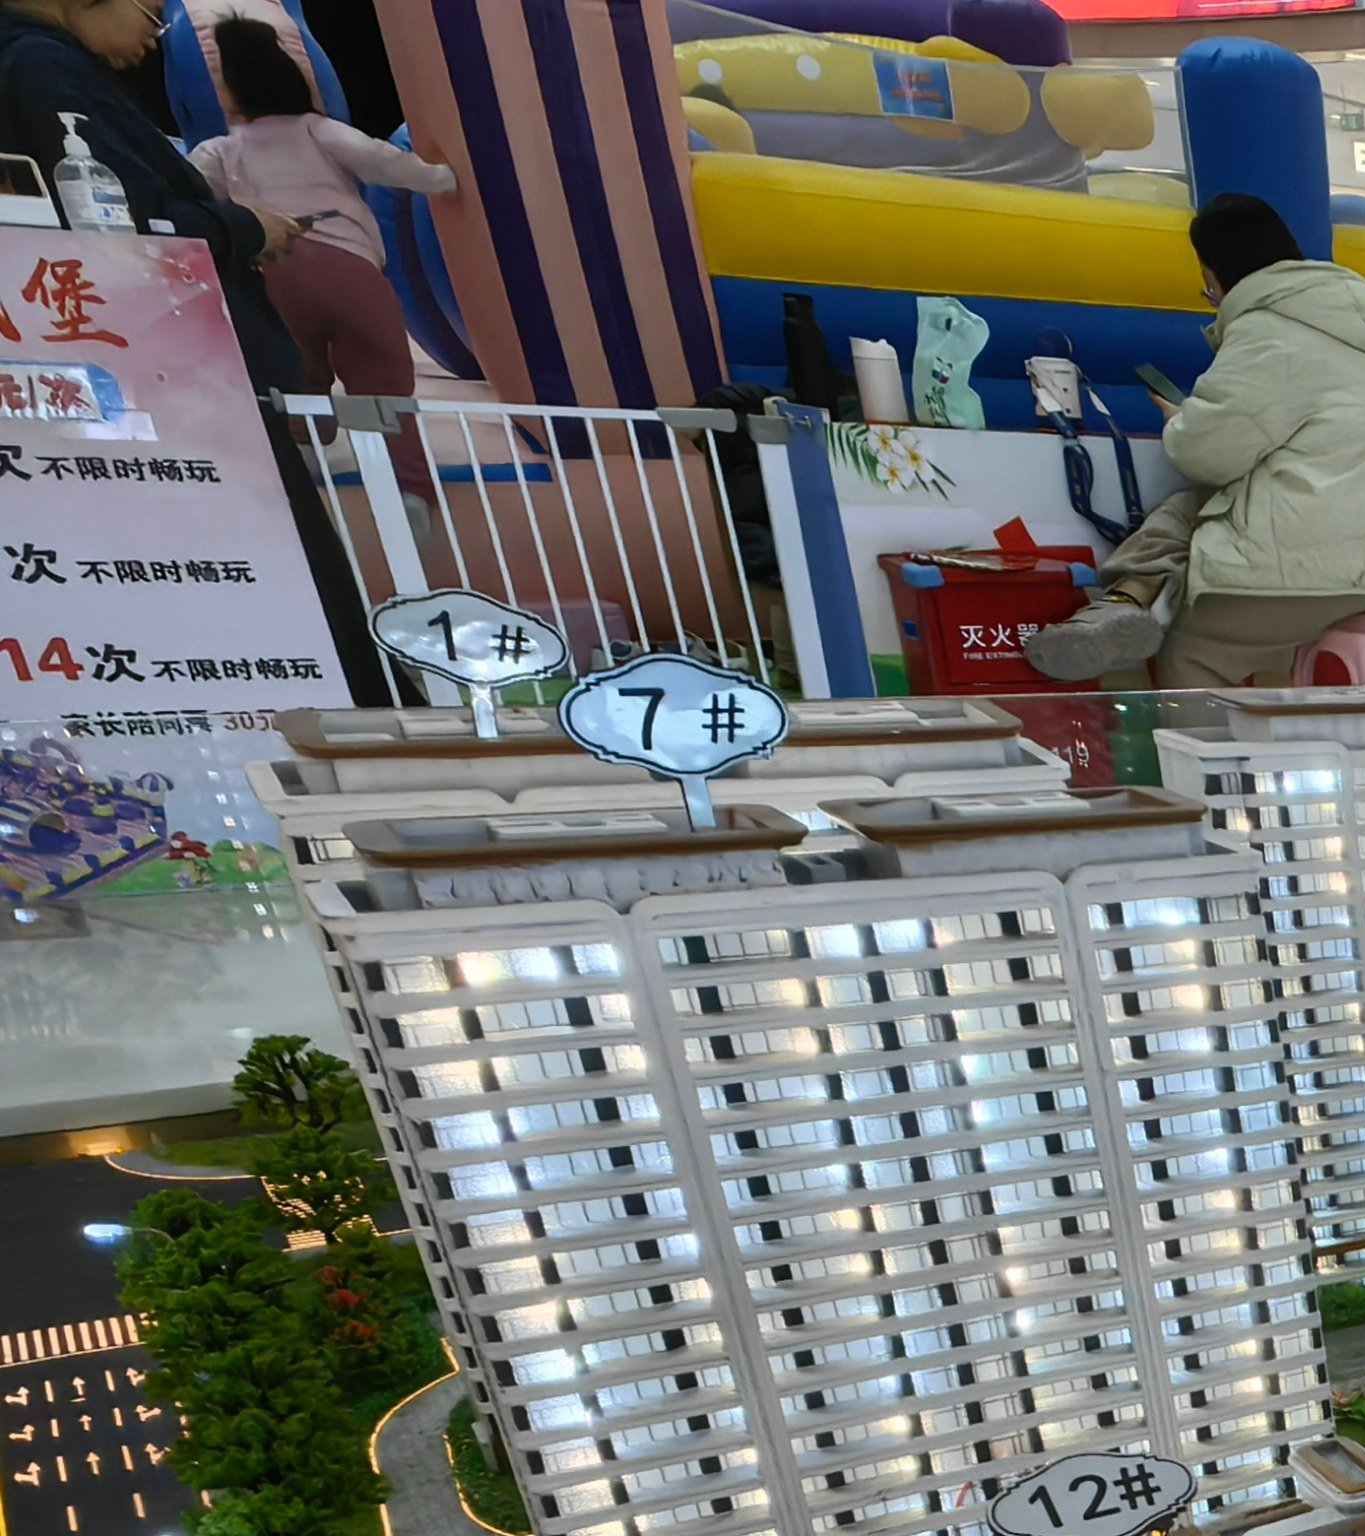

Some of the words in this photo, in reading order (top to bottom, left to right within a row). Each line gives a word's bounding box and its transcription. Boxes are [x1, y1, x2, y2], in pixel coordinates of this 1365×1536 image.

[0, 257, 129, 348] 堡
[35, 455, 222, 483] 不限时畅玩
[76, 560, 257, 584] 不限时畅玩
[427, 610, 531, 664] 1#
[959, 623, 1039, 649] 灭火器
[153, 657, 324, 682] 不限时畅玩
[619, 686, 745, 751] 7#
[1027, 1463, 1163, 1528] 12#
